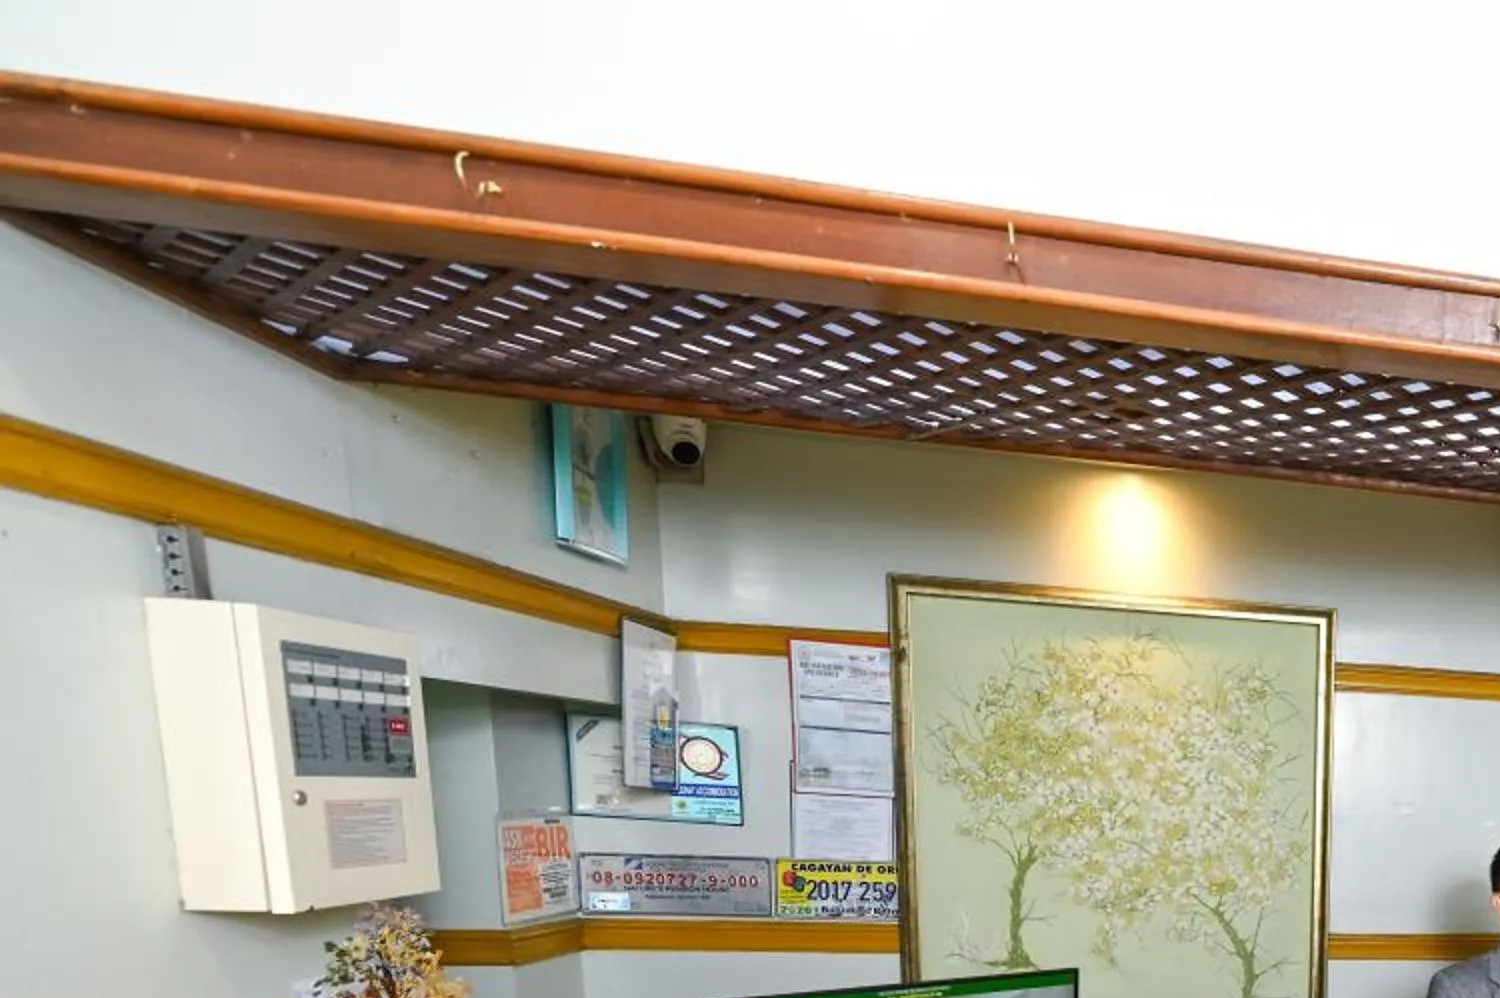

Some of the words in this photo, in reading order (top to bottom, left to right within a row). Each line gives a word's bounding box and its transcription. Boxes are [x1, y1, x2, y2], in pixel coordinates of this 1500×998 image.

[536, 825, 571, 860] BIR
[791, 863, 851, 873] CAGAYAN
[856, 865, 873, 874] DE
[807, 879, 853, 902] 2017
